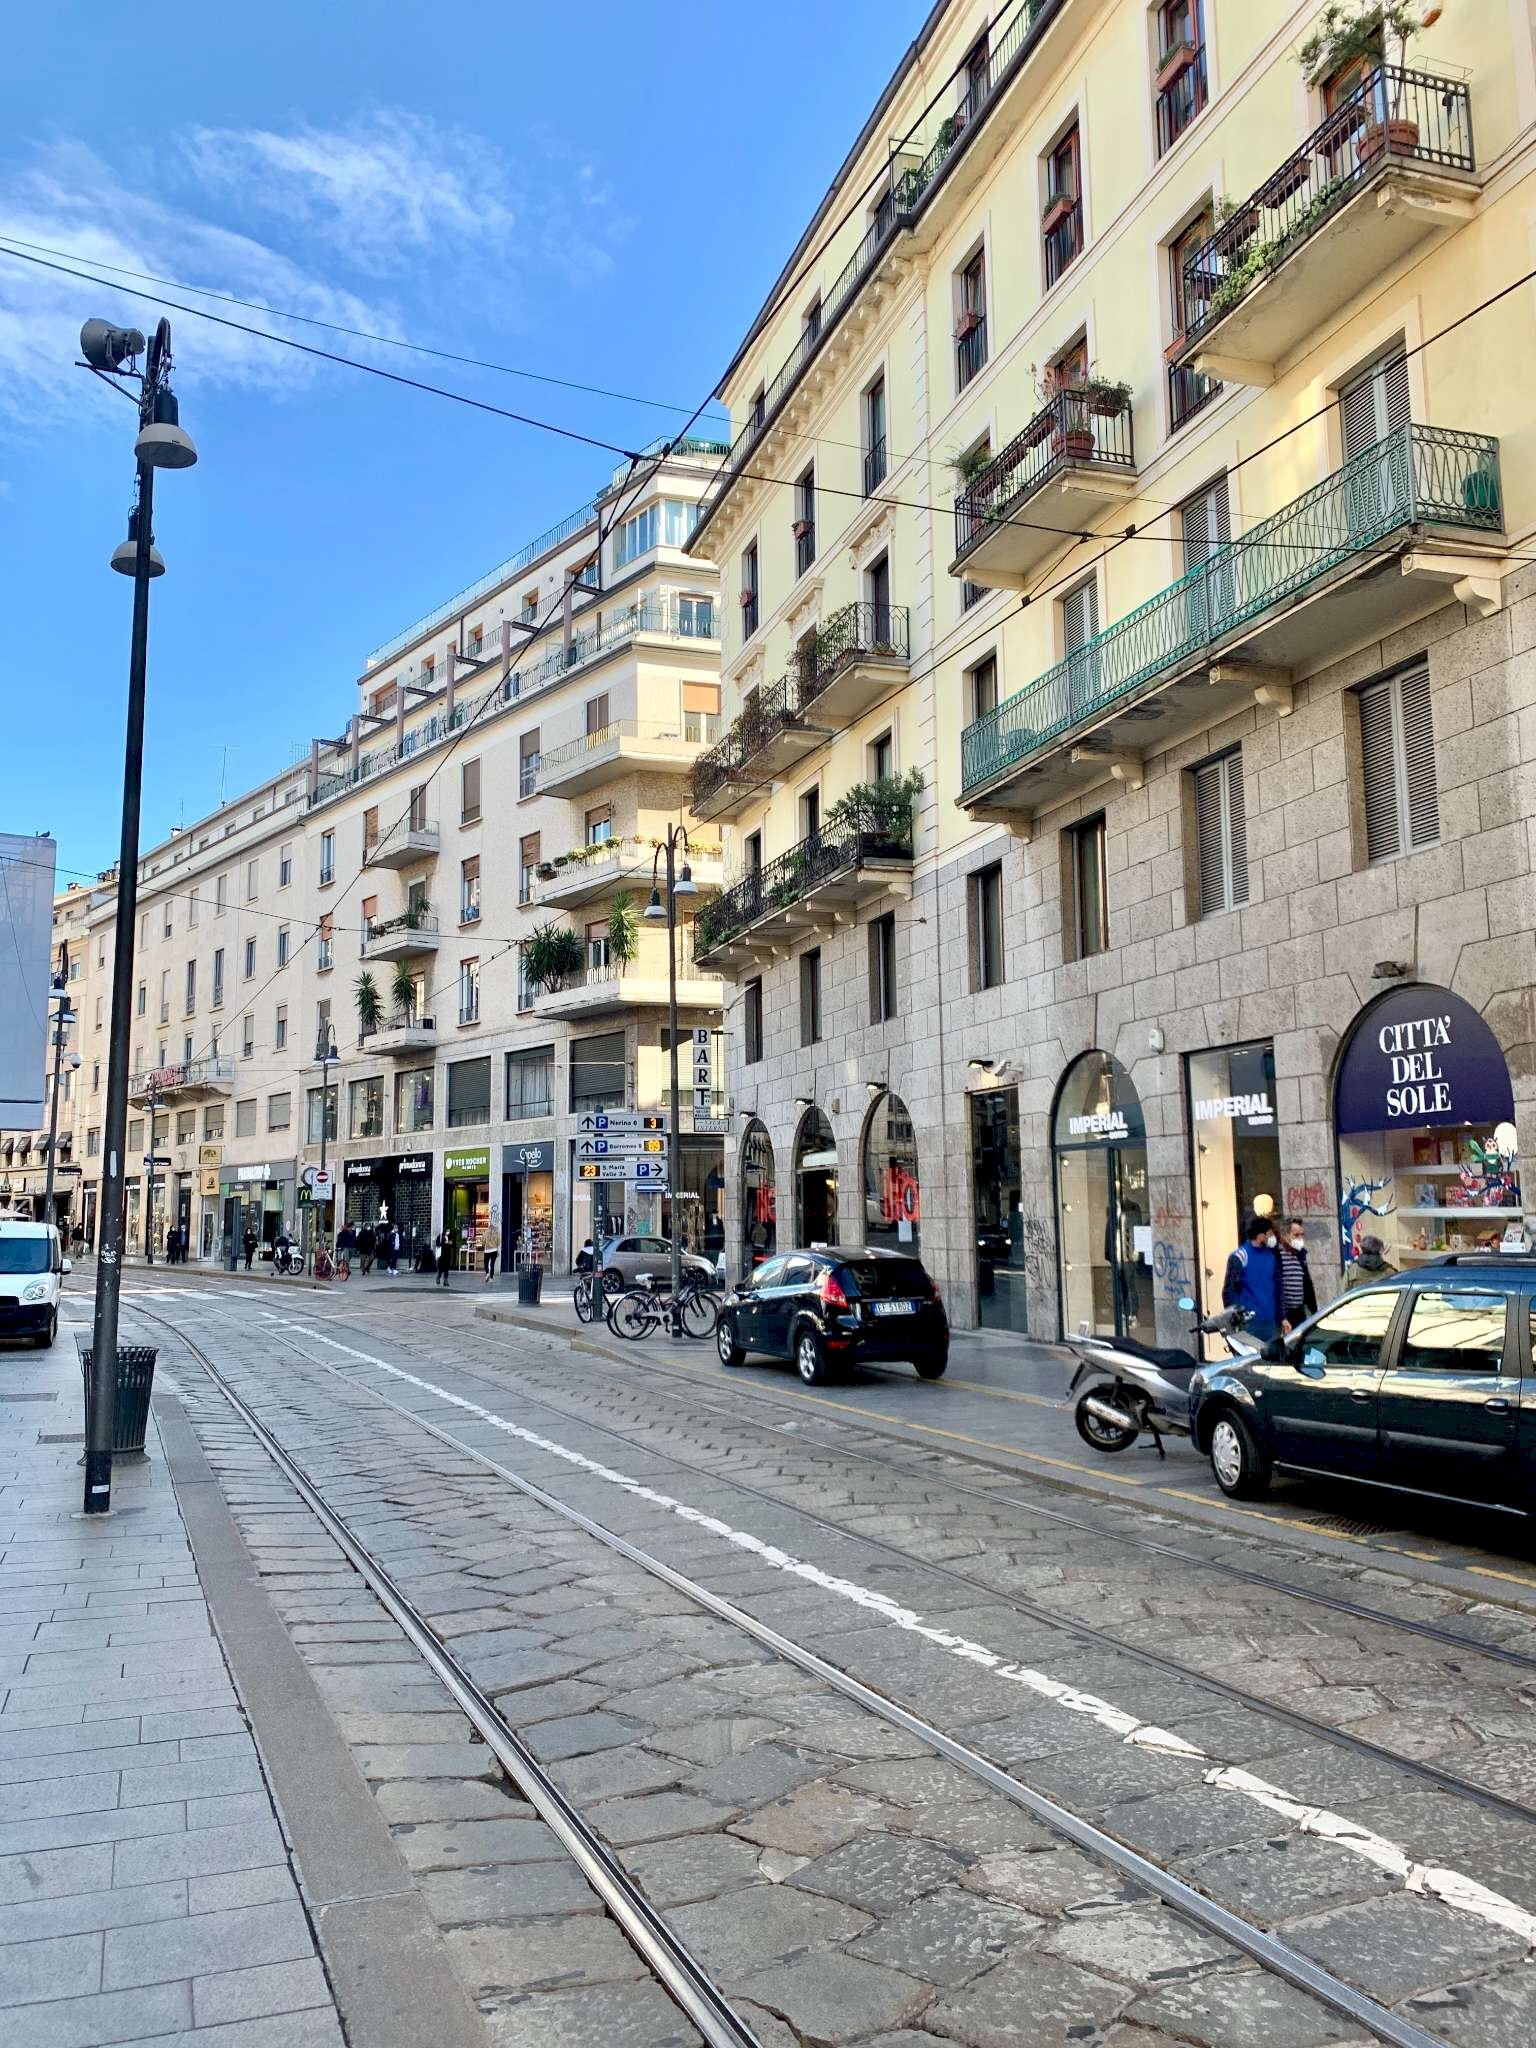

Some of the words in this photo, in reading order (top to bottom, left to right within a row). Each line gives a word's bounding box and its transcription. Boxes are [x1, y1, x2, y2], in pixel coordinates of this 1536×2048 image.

[1378, 1015, 1452, 1054] CITTA'
[1390, 1052, 1443, 1084] DEL
[1195, 1092, 1274, 1121] IMPERIAL
[1386, 1083, 1452, 1117] SOLE
[650, 1117, 657, 1129] 3
[1068, 1111, 1129, 1135] IMPERIAL
[466, 1157, 487, 1165] ROCHER
[583, 1164, 597, 1178] 23
